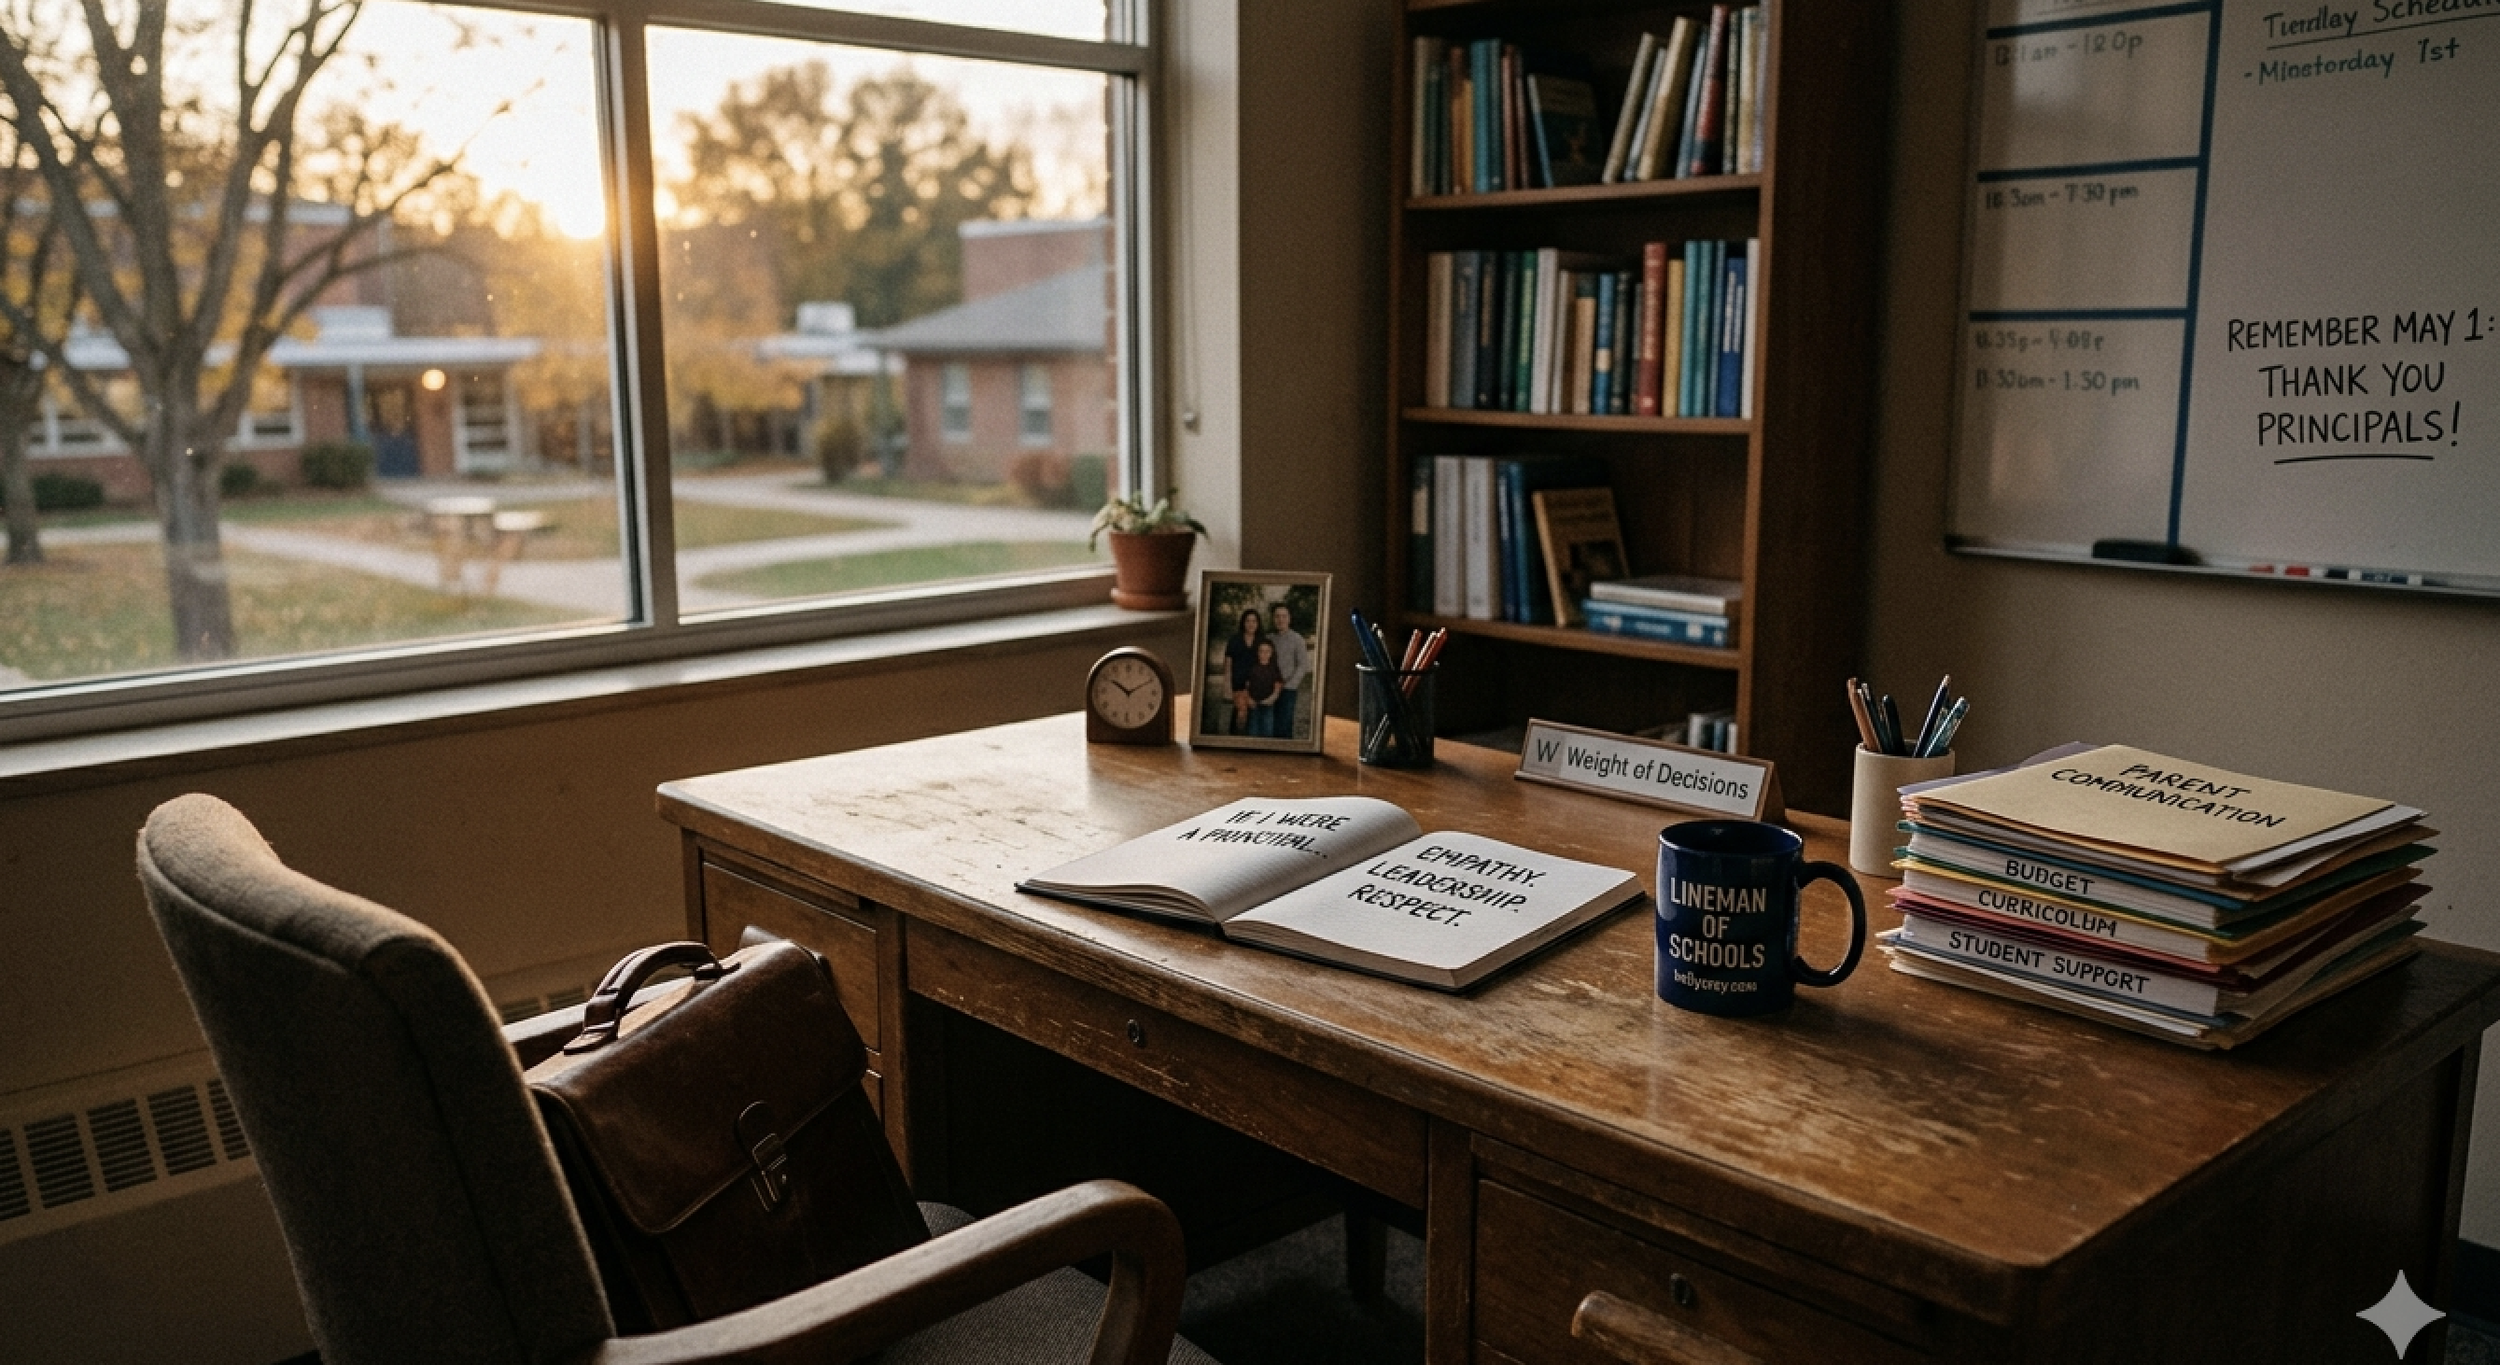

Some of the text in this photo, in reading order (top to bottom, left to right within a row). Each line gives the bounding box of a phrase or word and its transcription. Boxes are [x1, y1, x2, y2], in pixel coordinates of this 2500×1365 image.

[2228, 315, 2380, 352] REMEMBER
[2393, 310, 2456, 346] MAY
[2258, 360, 2444, 398] THANK YOU
[2257, 400, 2461, 447] PRINCIPALS!
[1537, 738, 1561, 763] W
[1567, 746, 1629, 777] Weight
[1656, 763, 1749, 800] Decisions
[2119, 763, 2252, 799] PARENT
[2051, 768, 2286, 828] COMMUNICATION
[1176, 826, 1201, 841] A
[1277, 812, 1351, 832] WERE
[1417, 845, 1546, 887] EMPATHY.
[2005, 859, 2095, 895] BUDGET
[1348, 883, 1472, 927] RESPECT.
[1670, 877, 1766, 913] LINEMAN
[1702, 914, 1731, 939] OF
[1669, 933, 1765, 968] SCHOOLS
[1949, 931, 2150, 994] STUDENT SUPPORT
